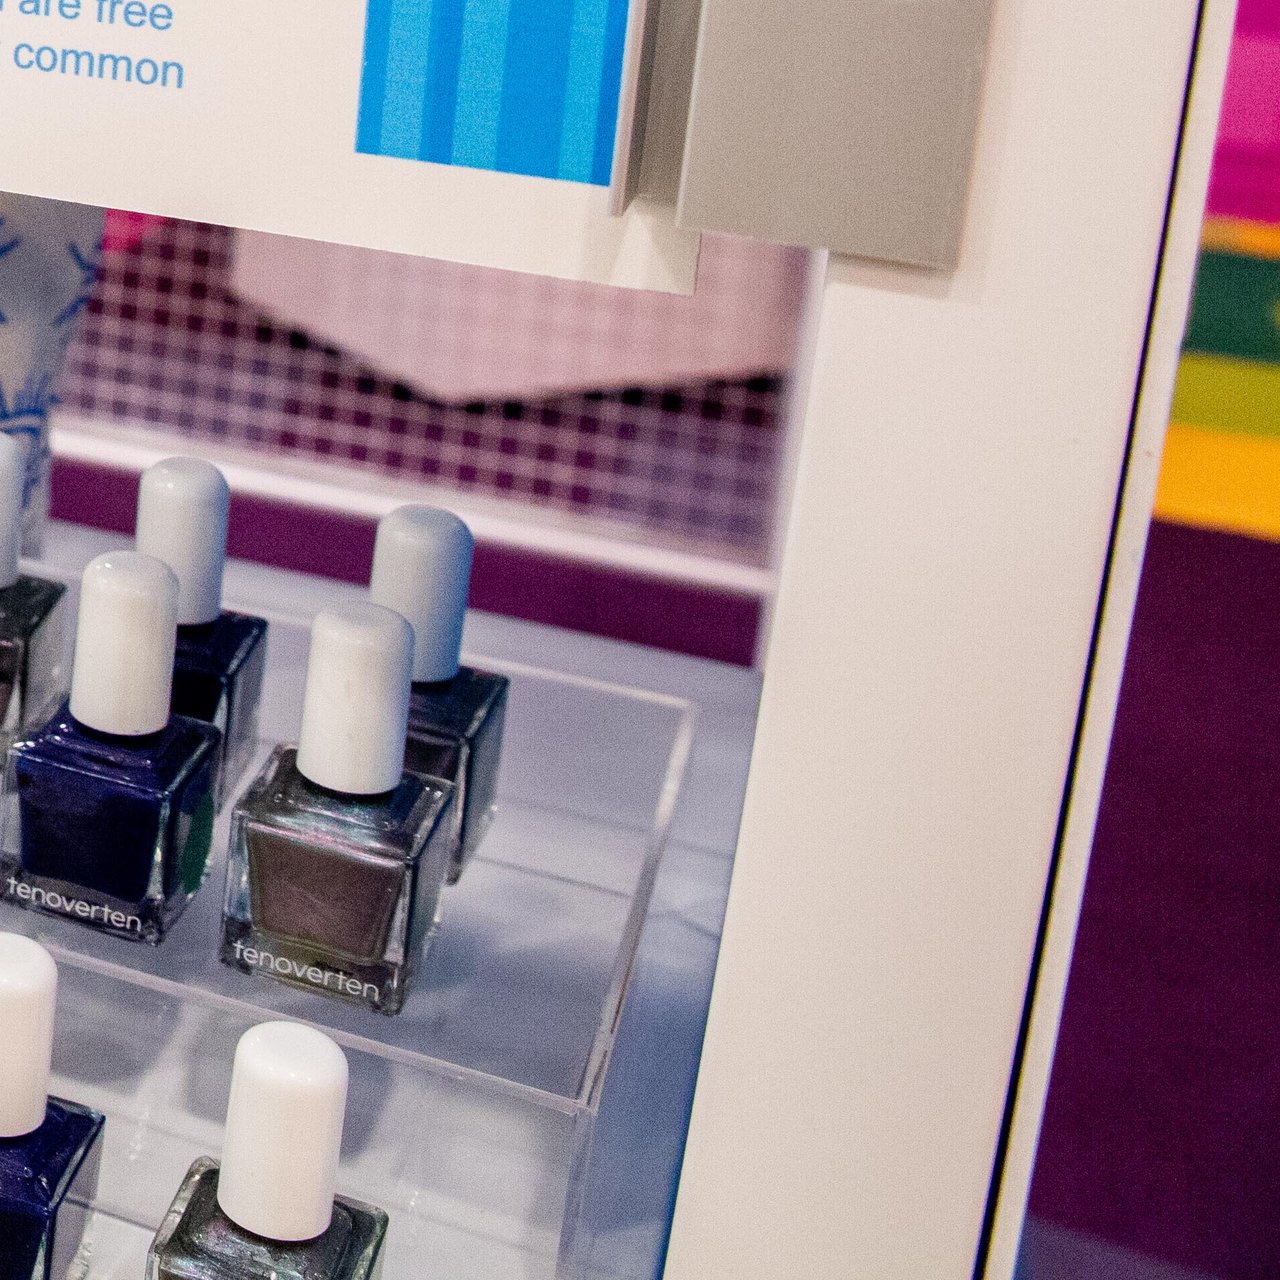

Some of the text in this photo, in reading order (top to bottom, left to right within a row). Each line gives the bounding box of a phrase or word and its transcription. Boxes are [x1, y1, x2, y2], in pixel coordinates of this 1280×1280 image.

[13, 43, 184, 88] common
[6, 876, 142, 932] tenoverten
[232, 939, 380, 1002] tenoverten
